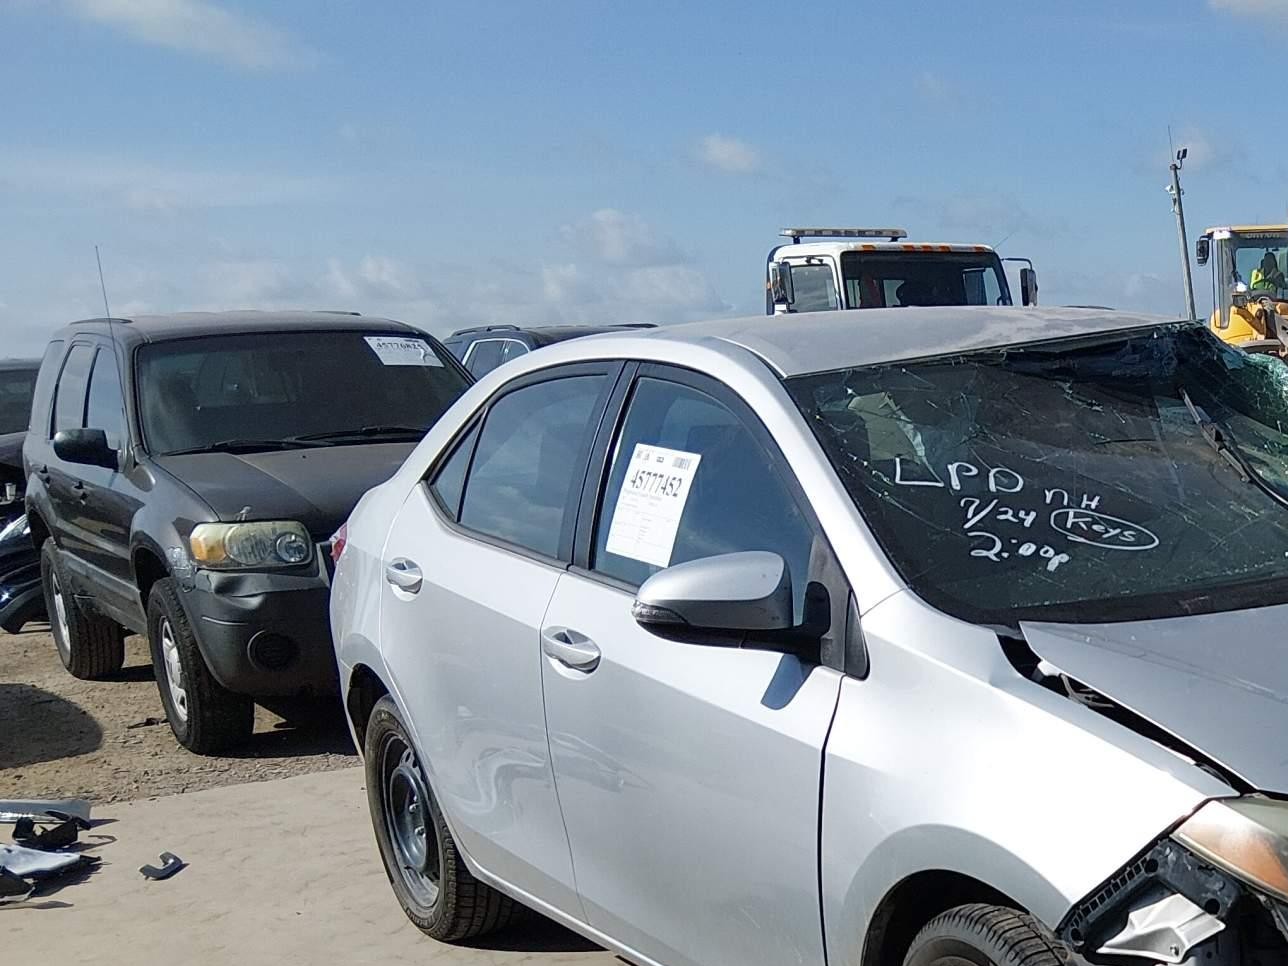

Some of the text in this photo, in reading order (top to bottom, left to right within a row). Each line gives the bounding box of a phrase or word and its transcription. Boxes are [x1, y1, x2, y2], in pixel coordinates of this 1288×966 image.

[630, 469, 682, 498] 45777452
[894, 456, 1024, 493] LPD
[1065, 509, 1138, 543] Keys
